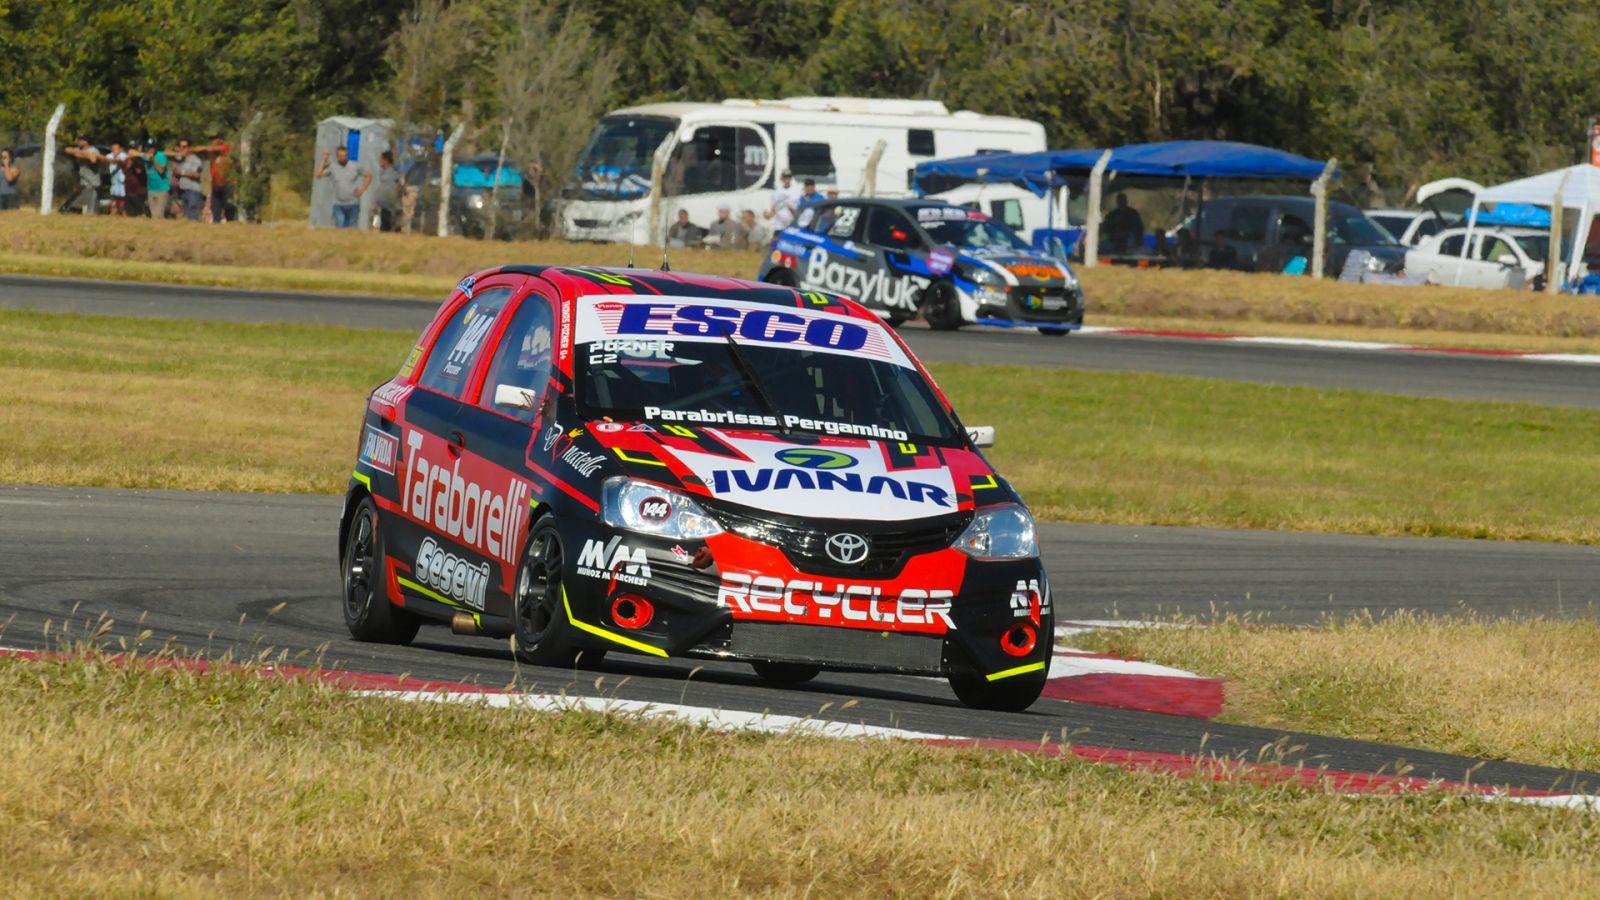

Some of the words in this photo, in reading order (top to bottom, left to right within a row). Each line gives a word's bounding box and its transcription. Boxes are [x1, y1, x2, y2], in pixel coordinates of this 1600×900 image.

[806, 247, 929, 312] Bazyluk
[617, 304, 868, 350] ESCO
[589, 342, 675, 353] POZNER
[589, 354, 618, 365] C2
[644, 406, 777, 427] Parabrisas
[784, 415, 908, 440] Pergamino
[403, 429, 527, 566] Taraborelli
[712, 469, 951, 507] IVANAR
[643, 502, 667, 518] 144
